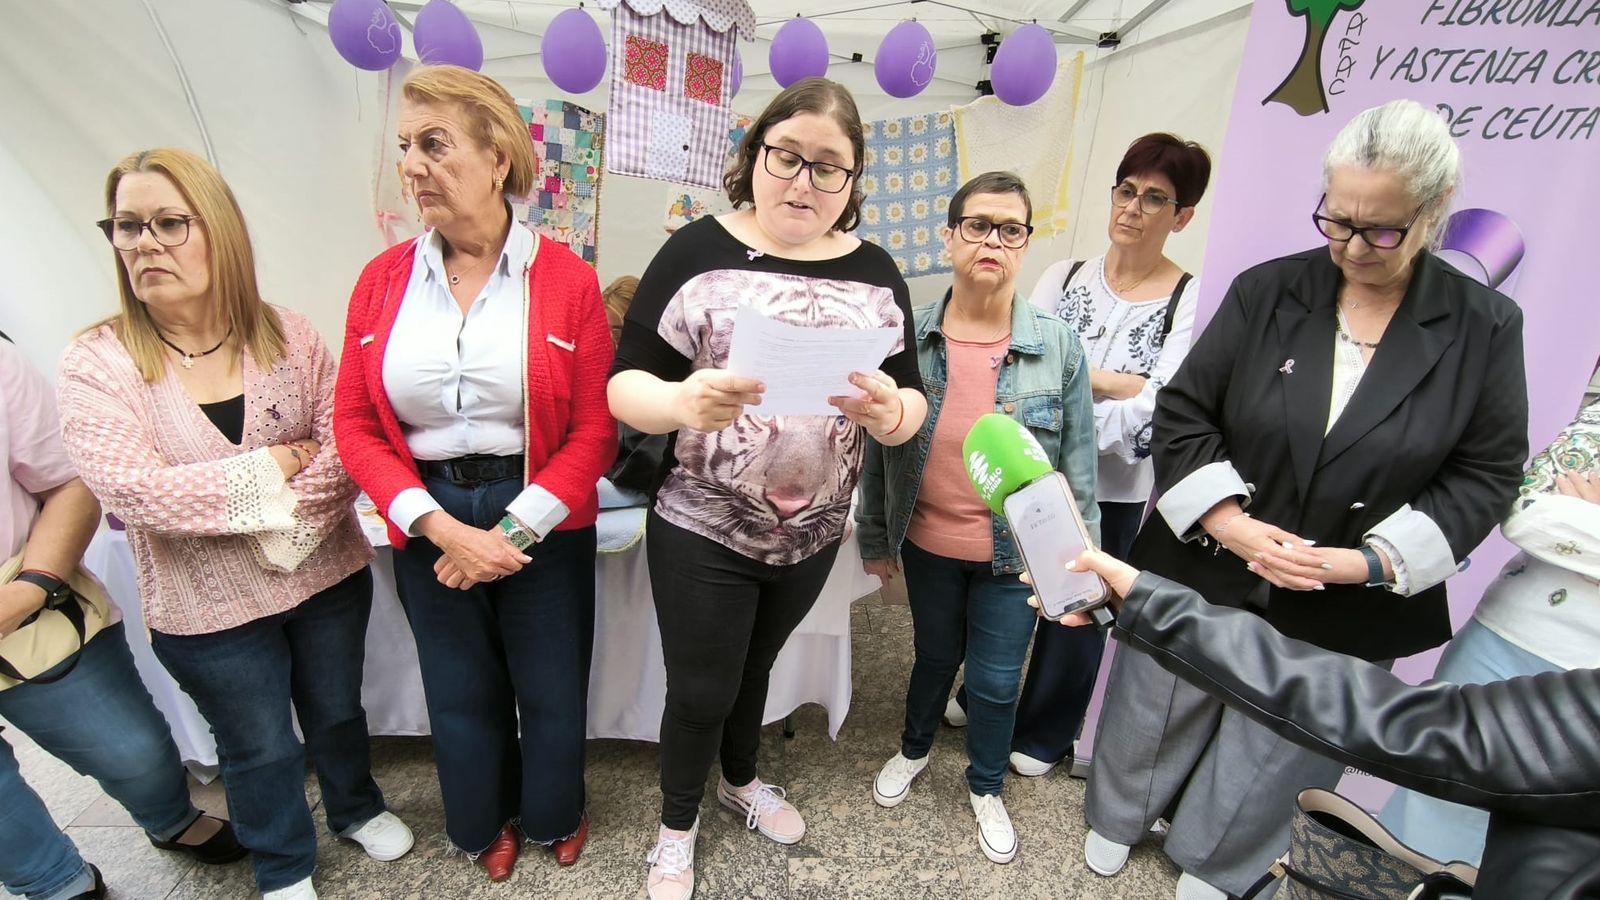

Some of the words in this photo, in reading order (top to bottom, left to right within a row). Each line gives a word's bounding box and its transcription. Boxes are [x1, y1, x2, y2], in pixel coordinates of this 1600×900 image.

[1329, 12, 1368, 95] AFAC
[1370, 45, 1396, 80] Y
[1390, 46, 1548, 85] ASTENIA
[1553, 49, 1600, 84] CR
[1481, 104, 1600, 140] CEUTA
